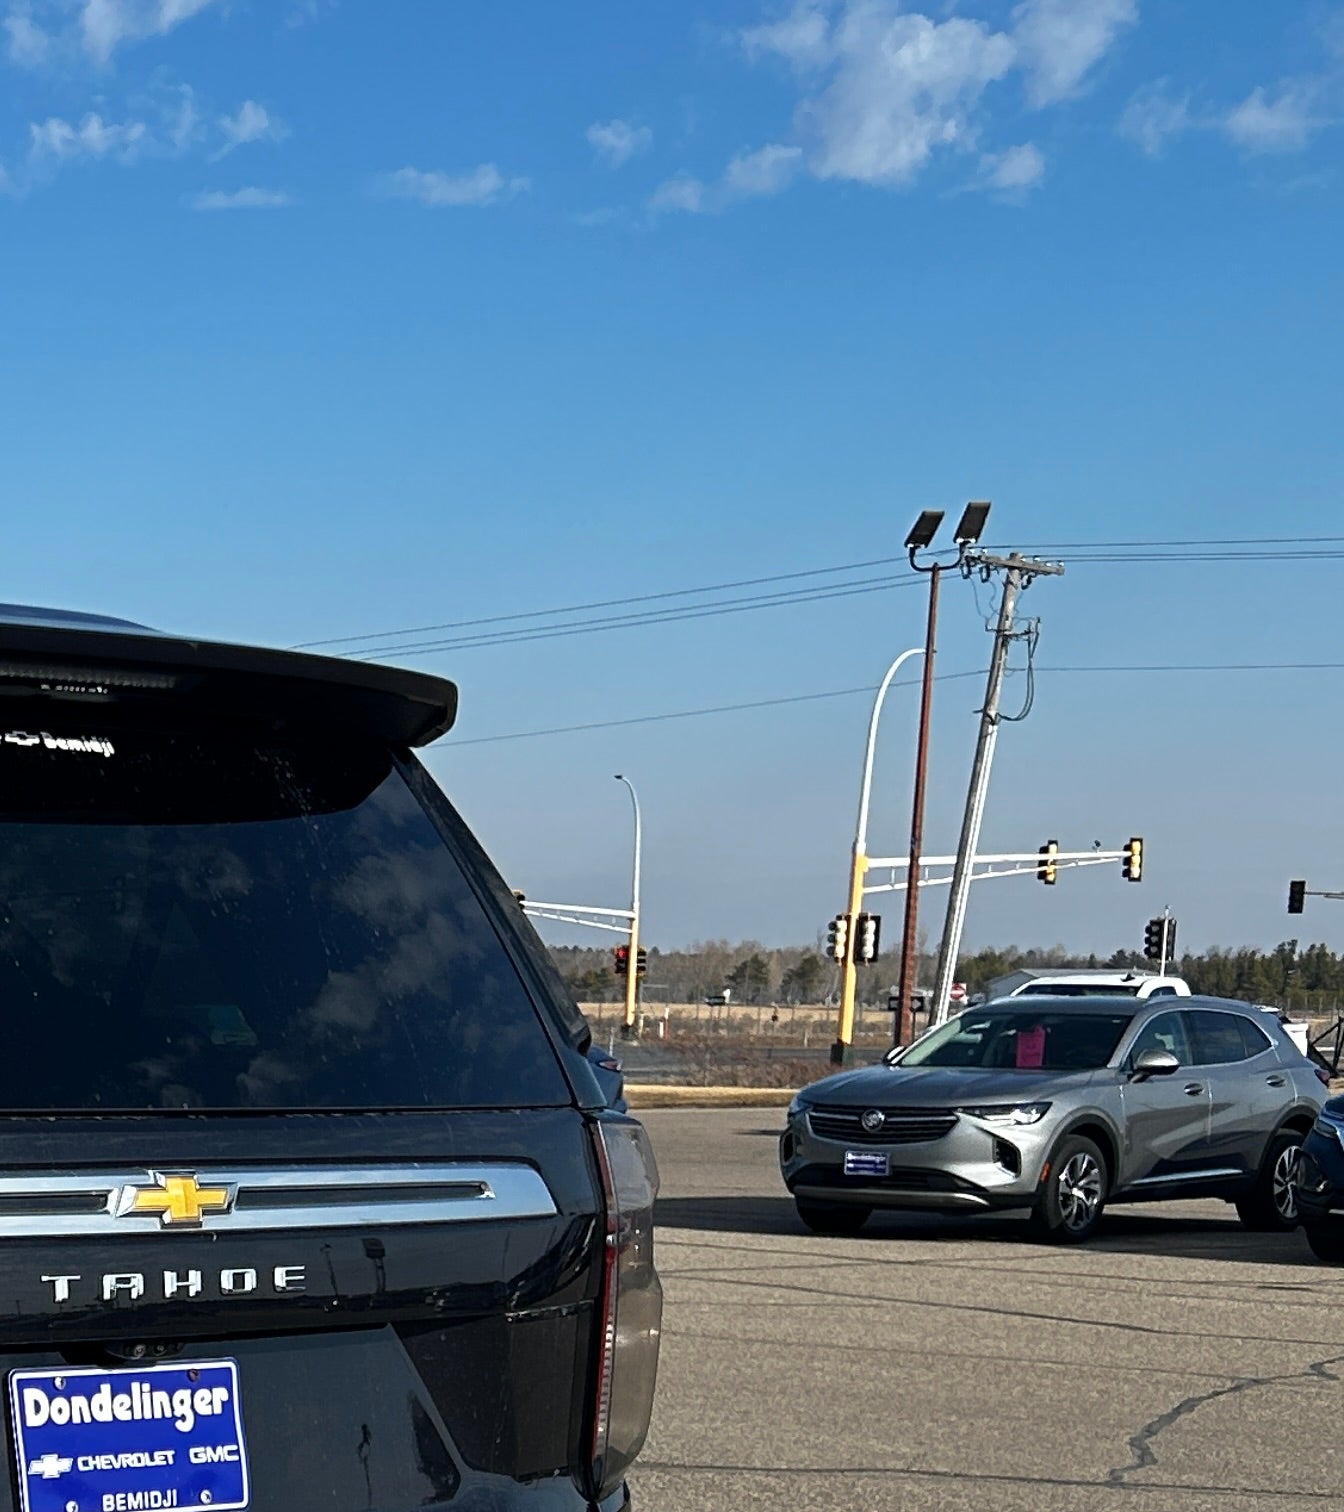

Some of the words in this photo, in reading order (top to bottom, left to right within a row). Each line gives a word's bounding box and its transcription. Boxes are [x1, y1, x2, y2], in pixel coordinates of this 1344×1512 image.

[40, 1265, 306, 1303] TAHOE
[22, 1381, 230, 1433] Dondelinger
[77, 1450, 176, 1472] CHEVROLET
[189, 1444, 240, 1464] GMC
[102, 1489, 178, 1512] BEMIDJI
